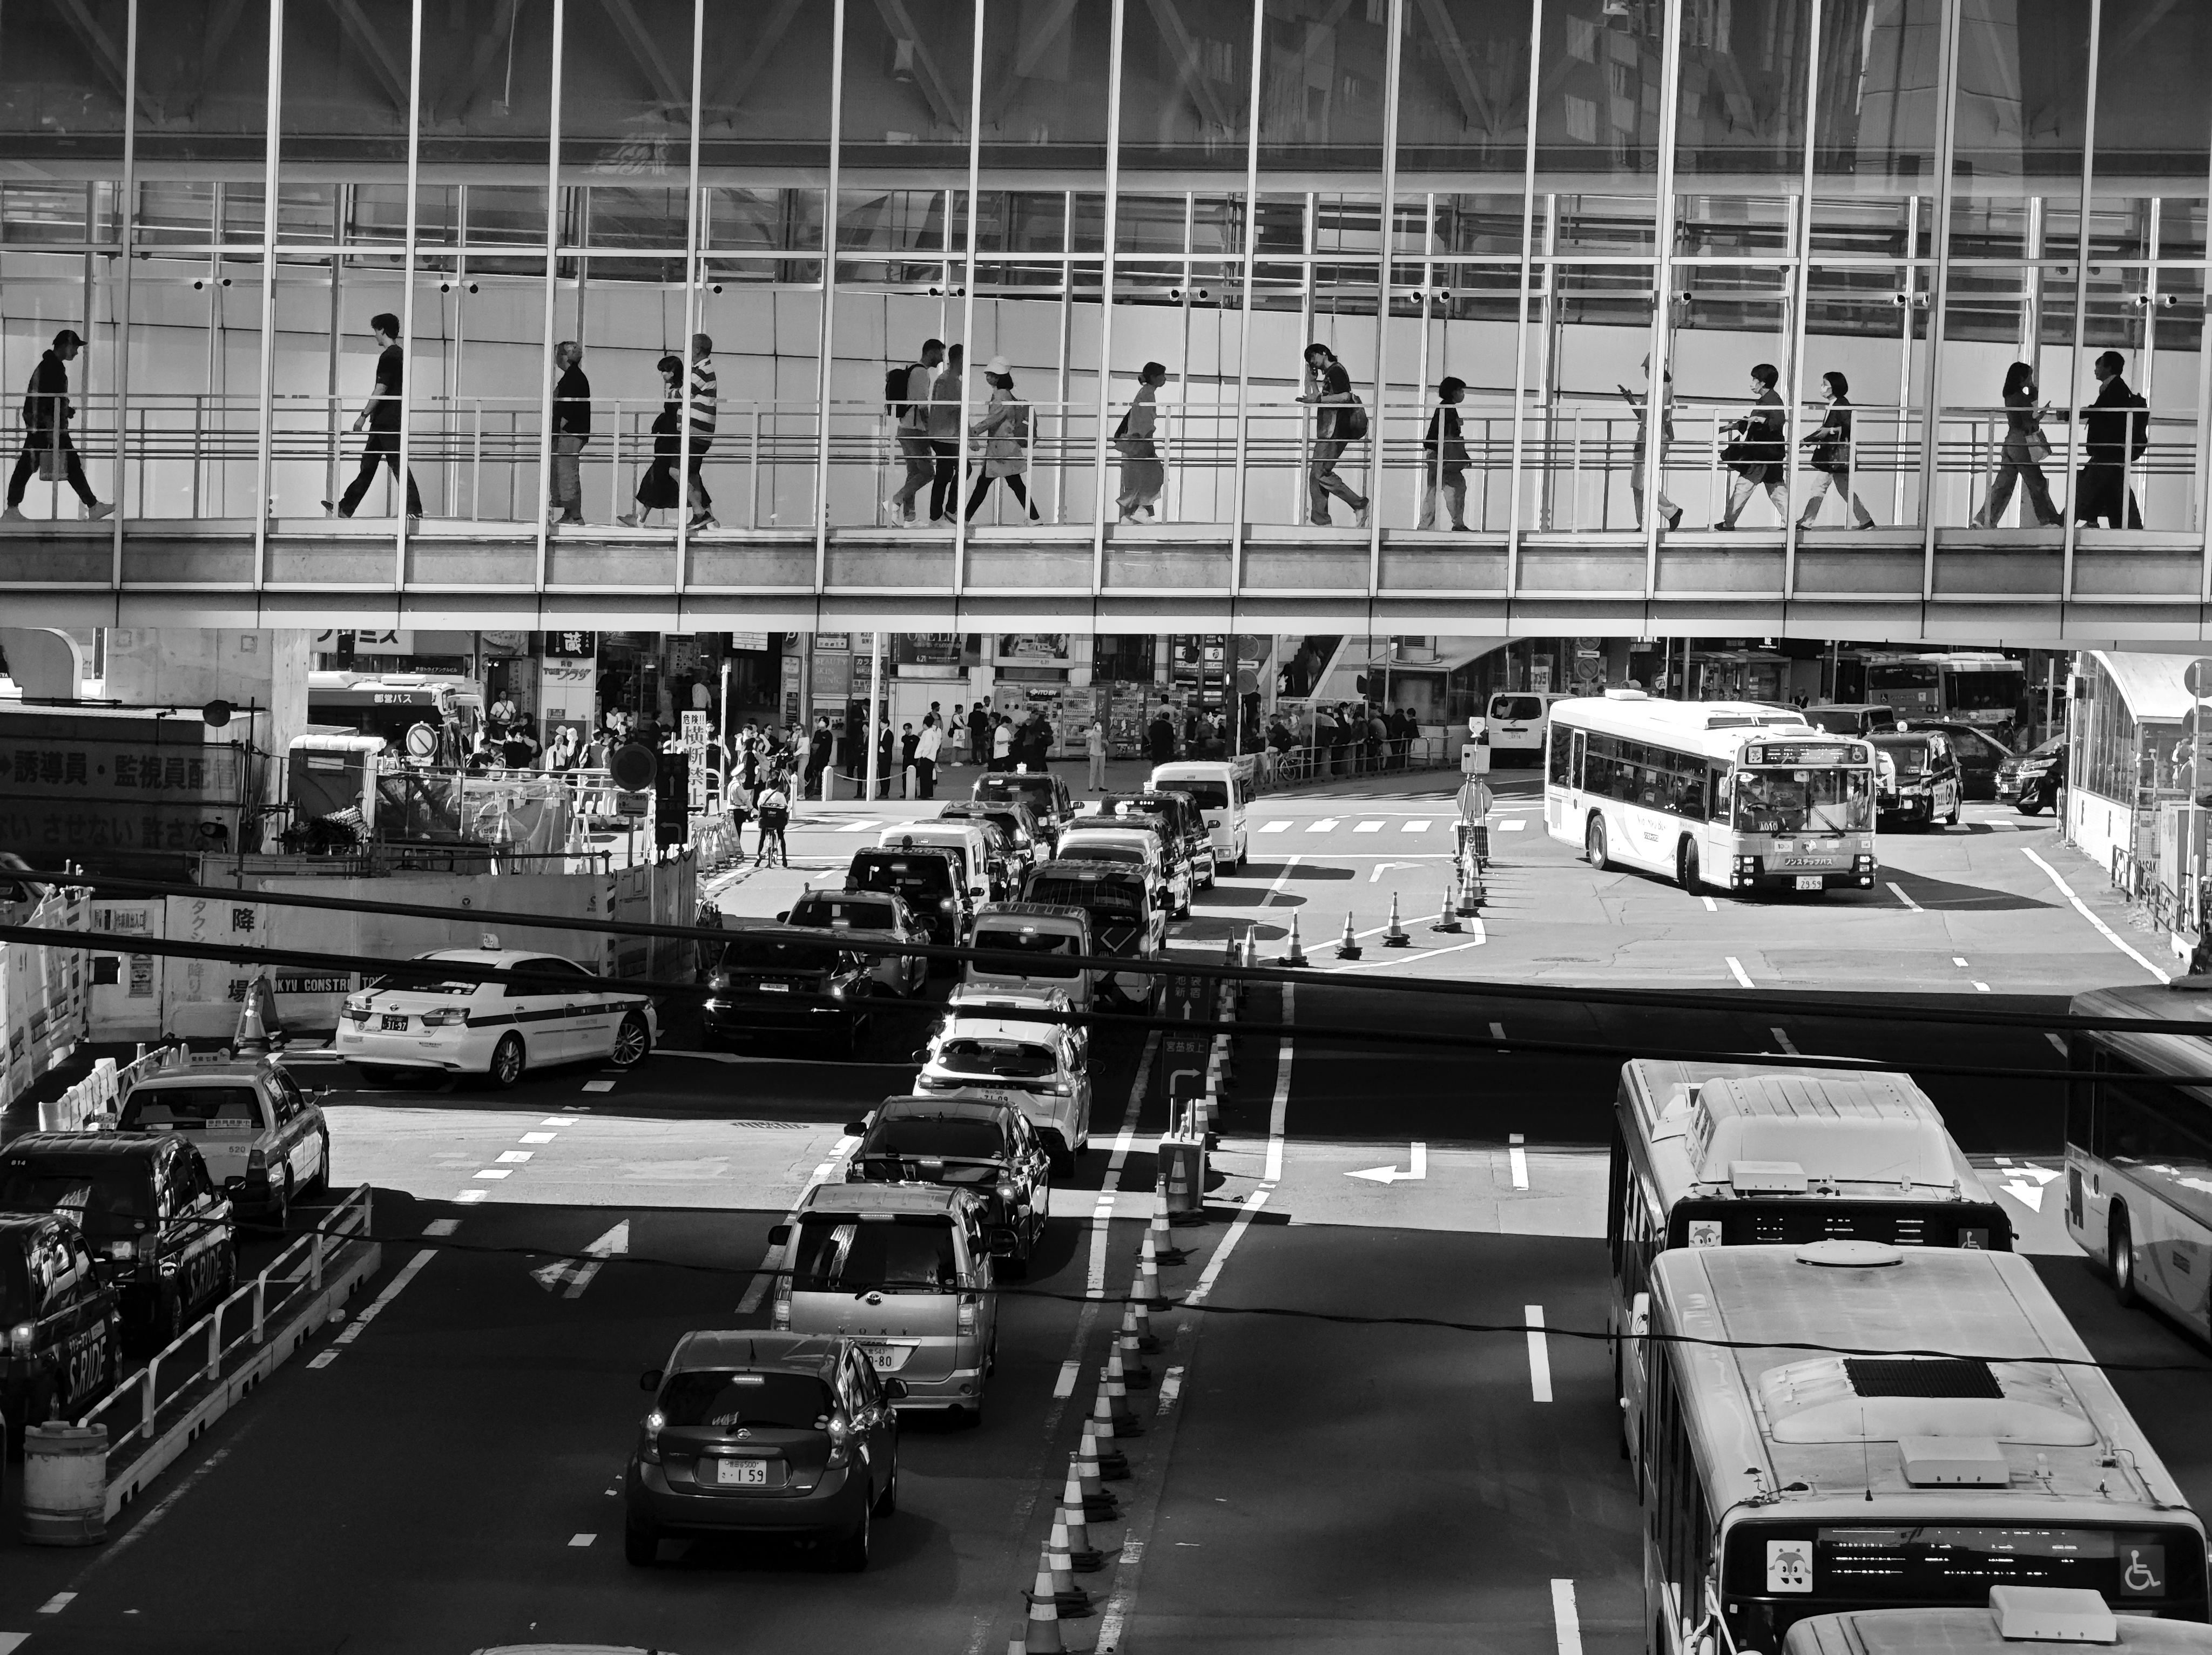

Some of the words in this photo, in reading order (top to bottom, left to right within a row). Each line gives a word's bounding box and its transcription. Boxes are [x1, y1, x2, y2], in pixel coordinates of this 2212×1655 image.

[374, 694, 412, 704] 都営バス
[14, 749, 235, 791] 誘導員・監視員配置
[683, 726, 705, 806] 横断禁止
[42, 814, 133, 846] させない
[141, 816, 212, 848] 許さな
[227, 908, 255, 1003] 降場
[1175, 975, 1202, 986] 池袋
[1175, 987, 1201, 998] 新宿
[387, 1021, 407, 1031] 31-97
[1166, 1041, 1204, 1053] 宮益坂上
[188, 1244, 222, 1306] S.RIDE
[838, 1325, 908, 1335] VOXY
[868, 1356, 892, 1367] 0-80
[68, 1335, 106, 1404] S.RIDE
